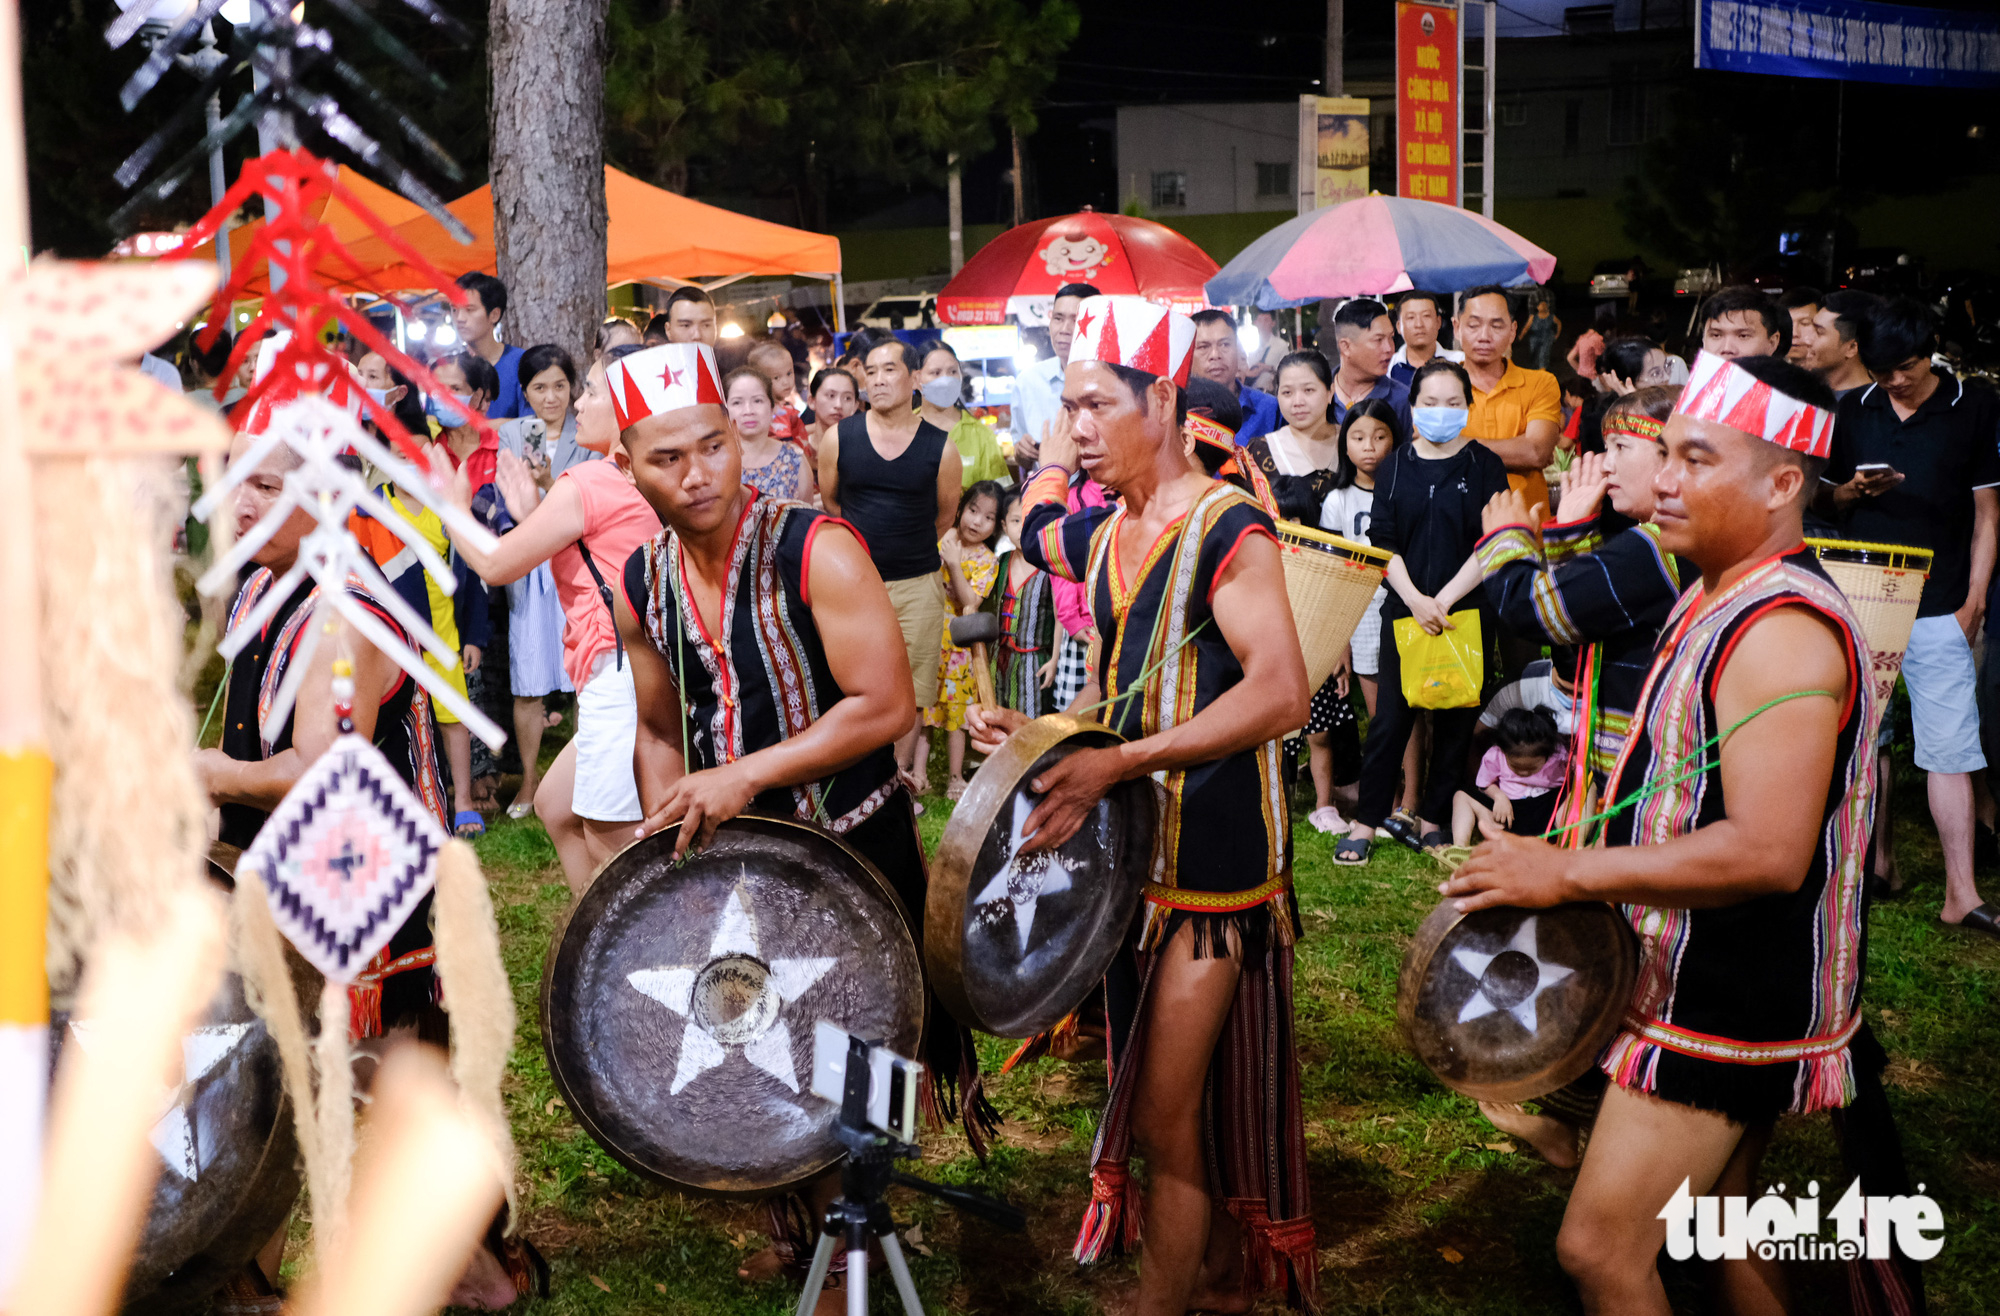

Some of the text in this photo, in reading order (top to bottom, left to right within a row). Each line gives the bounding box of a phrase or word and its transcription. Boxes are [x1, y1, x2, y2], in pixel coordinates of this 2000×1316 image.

[1407, 73, 1431, 105] CỘNG
[1415, 106, 1442, 138] XÃ HỘI
[1406, 136, 1450, 166] CHỦ NGHĨA
[1409, 170, 1448, 199] VIỆT NAM
